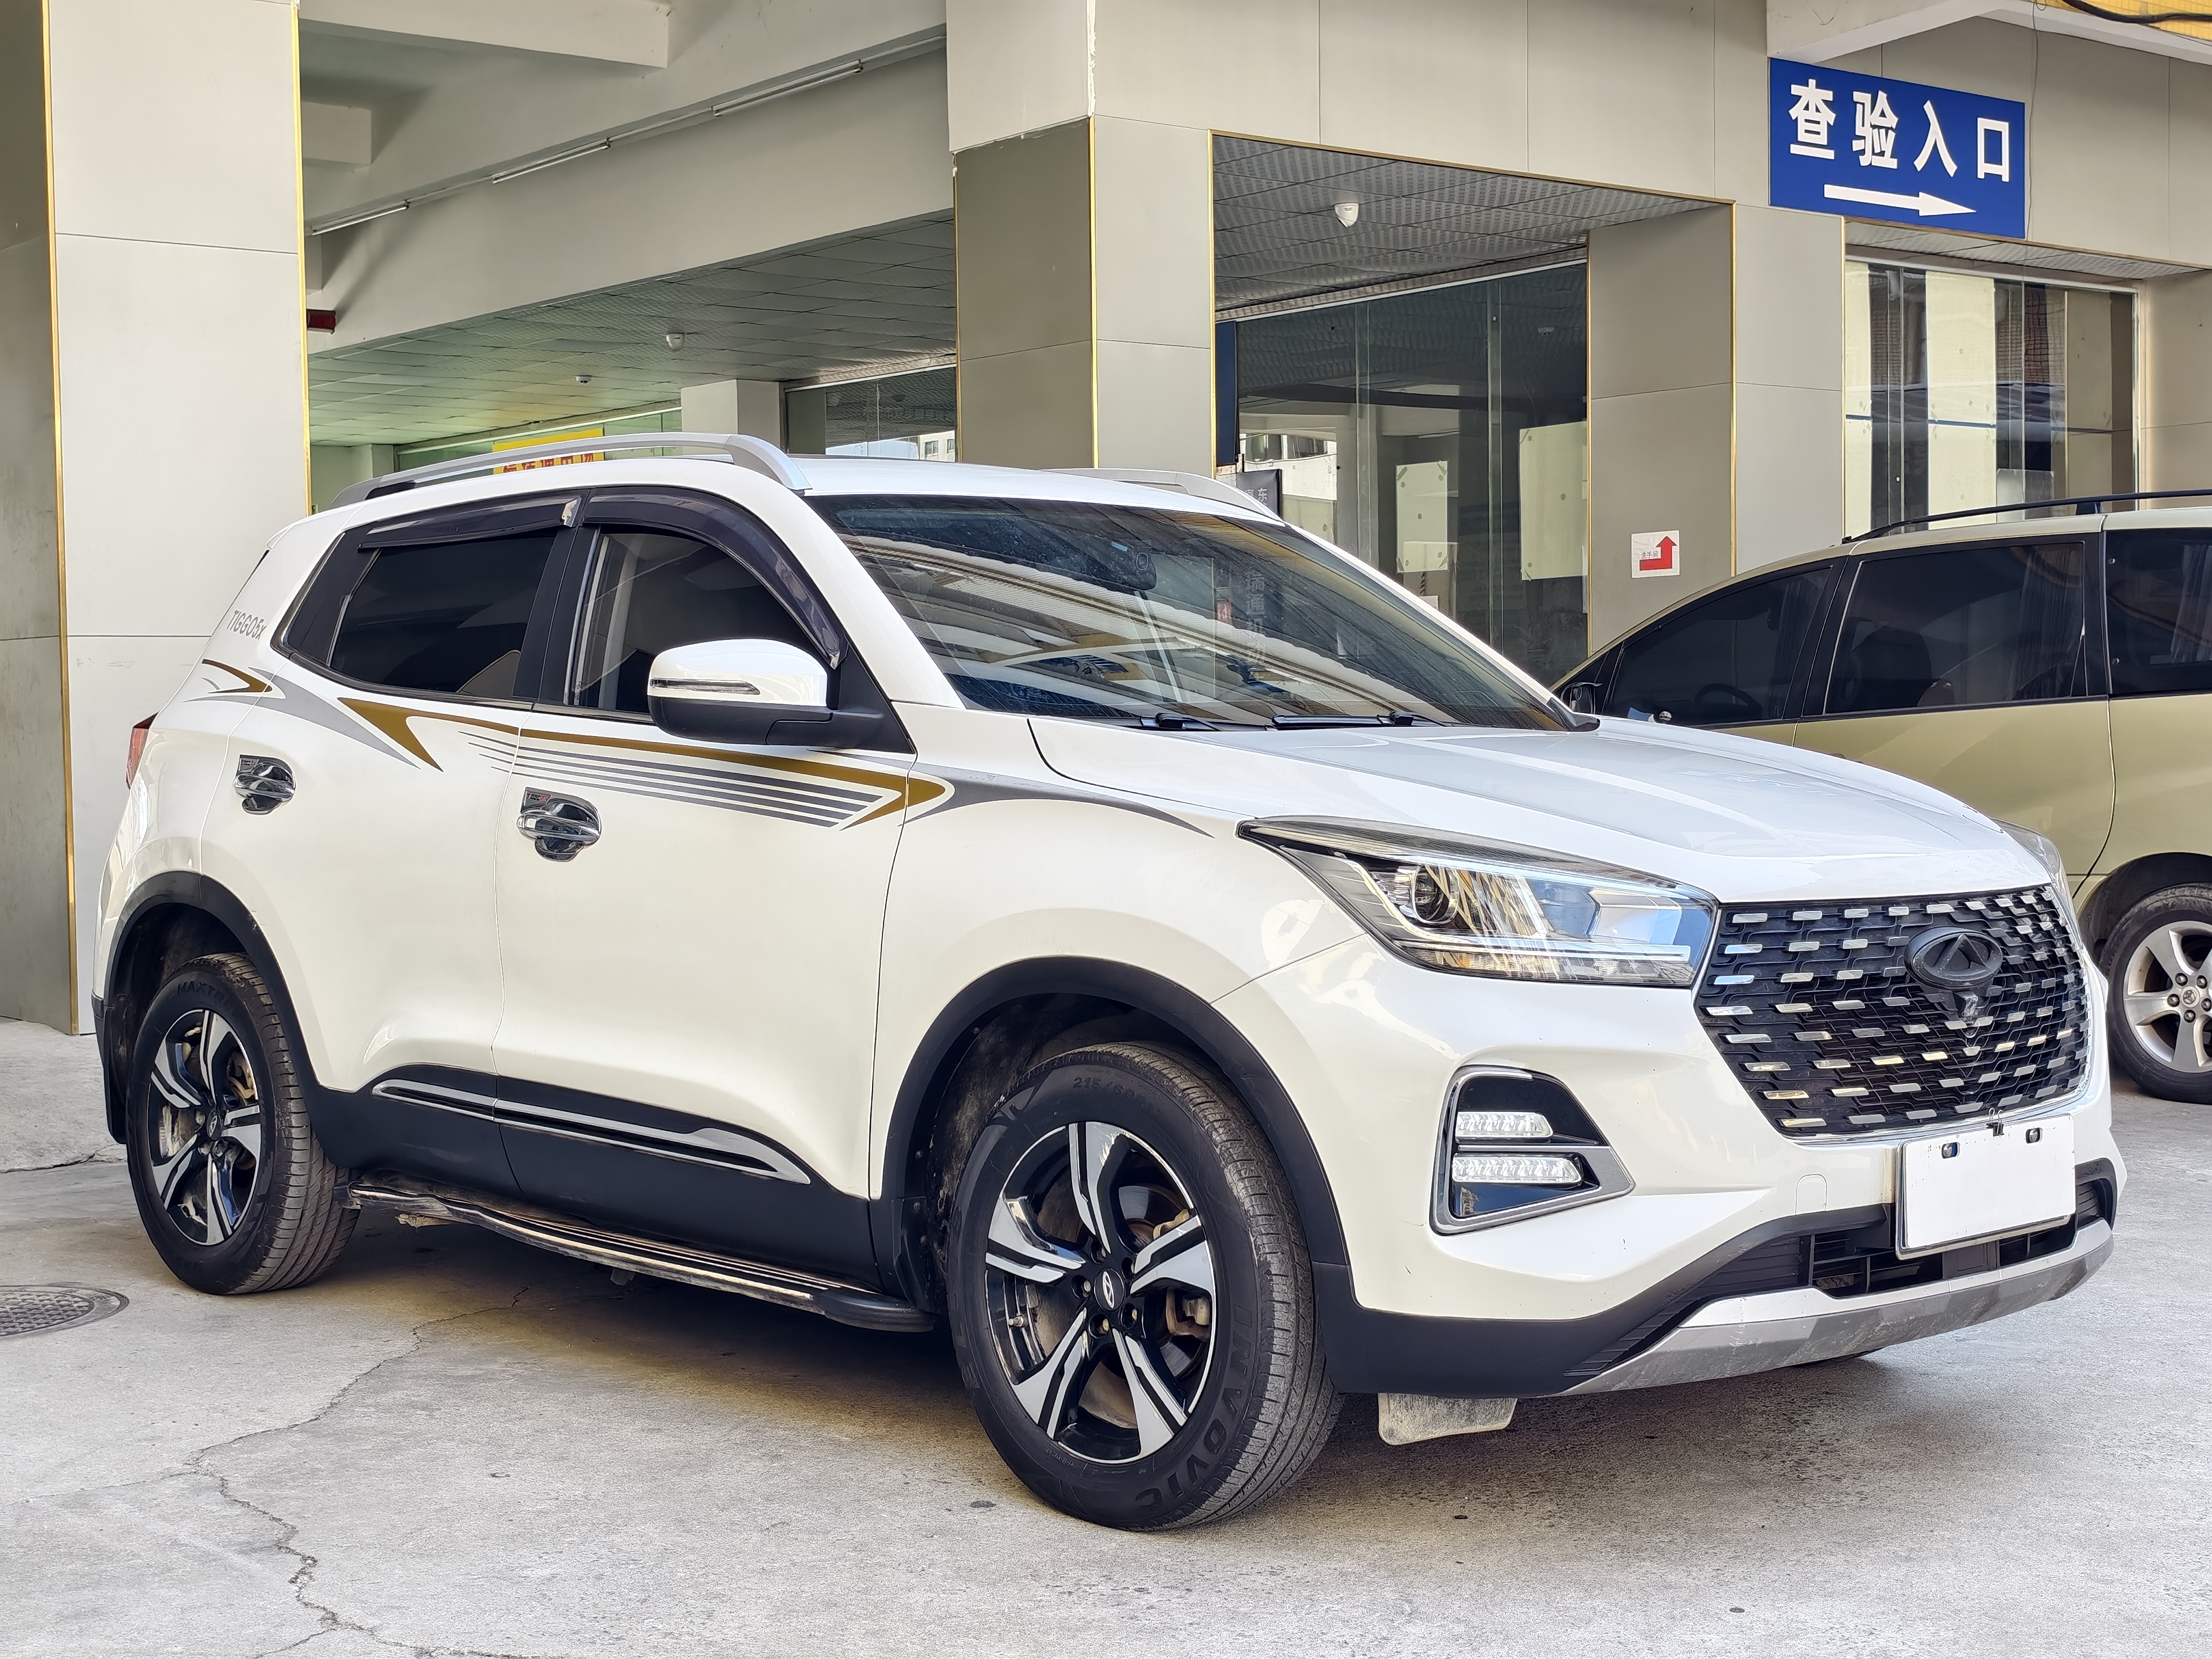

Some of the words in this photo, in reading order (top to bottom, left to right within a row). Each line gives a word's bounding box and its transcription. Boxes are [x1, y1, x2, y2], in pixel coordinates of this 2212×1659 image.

[1789, 79, 2009, 182] 查验入口
[1641, 551, 1658, 559] 洗手间
[1135, 1304, 1252, 1510] INVOVIC
